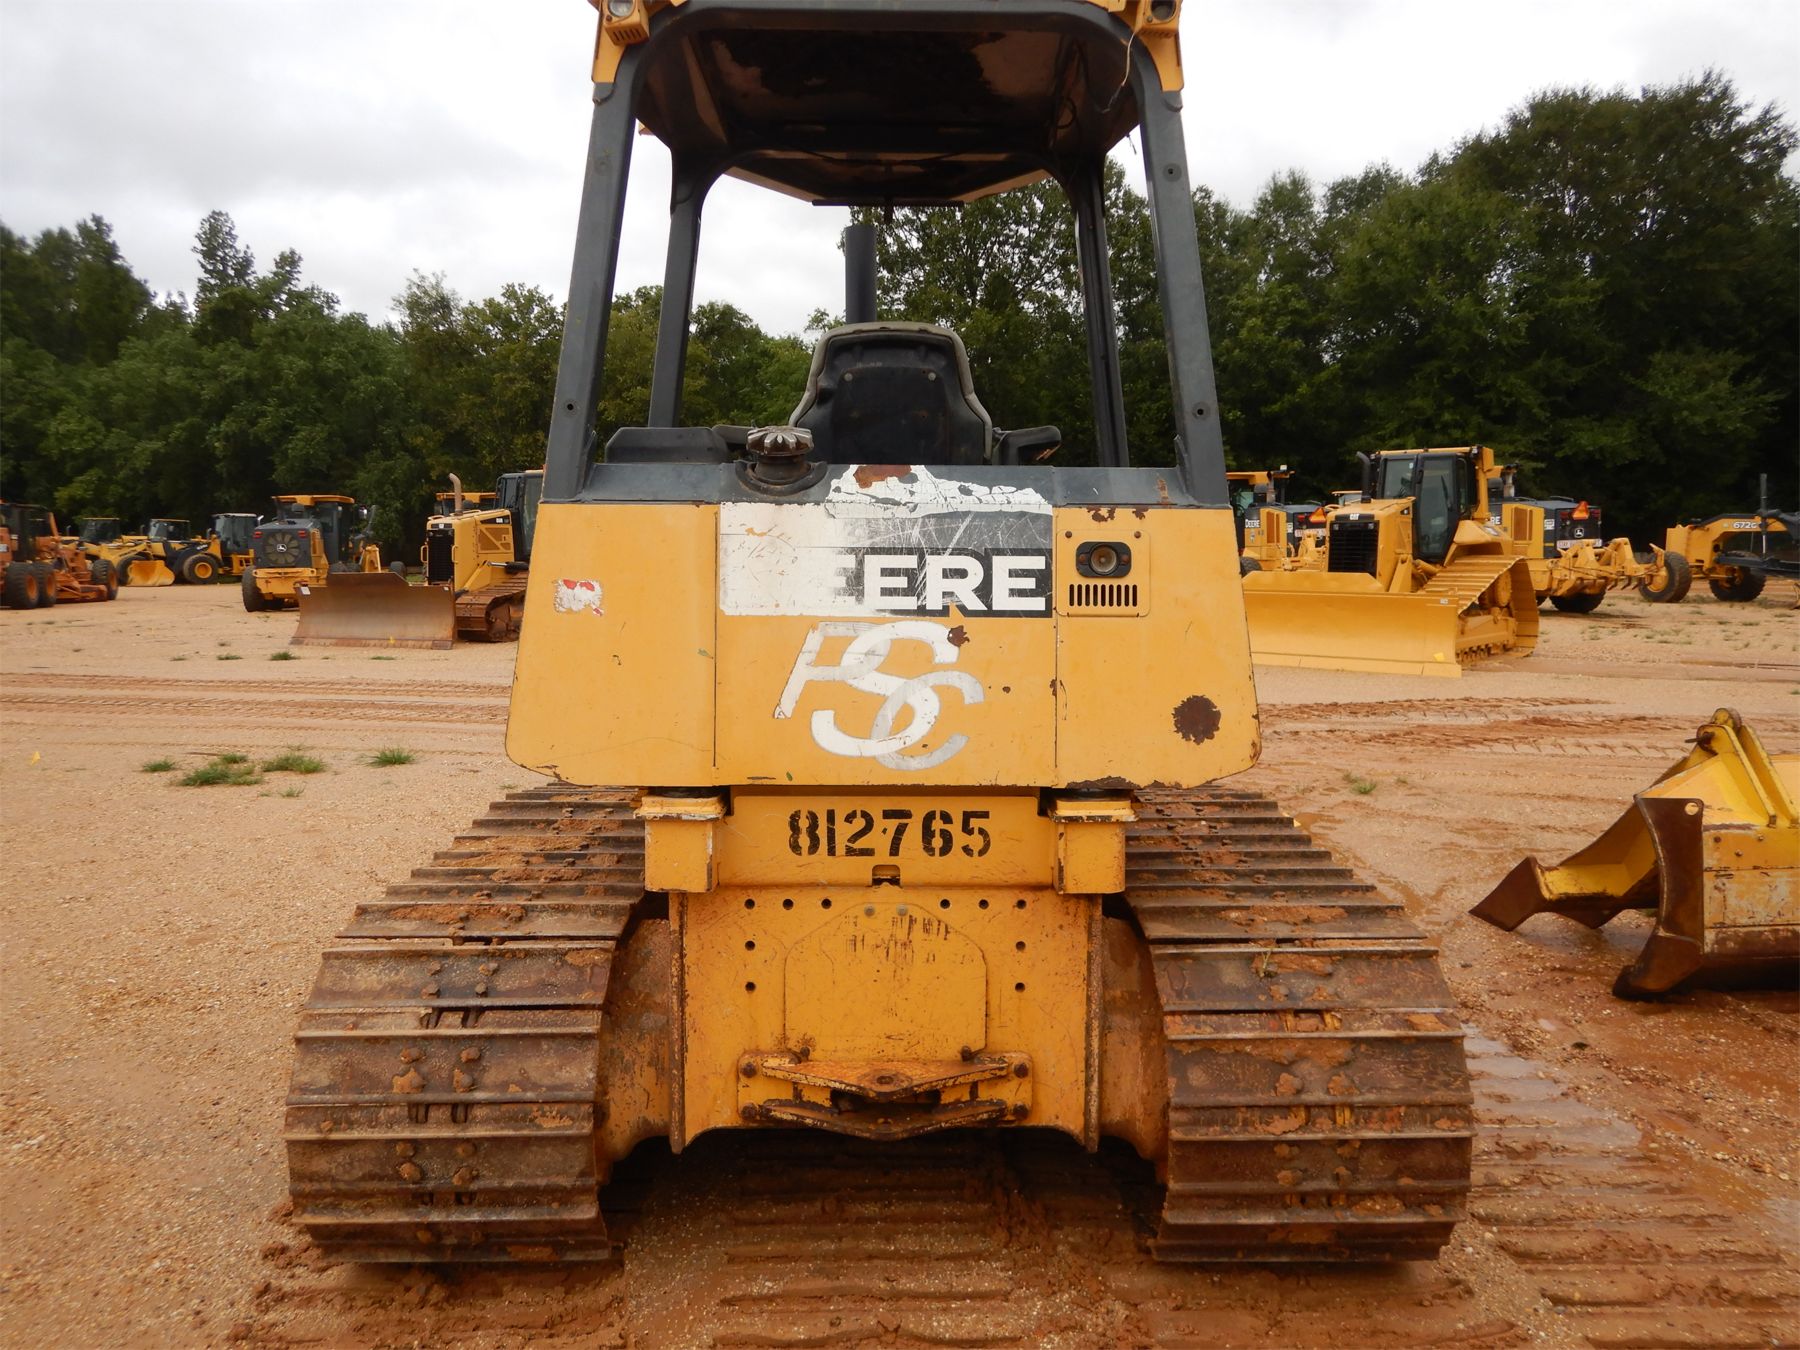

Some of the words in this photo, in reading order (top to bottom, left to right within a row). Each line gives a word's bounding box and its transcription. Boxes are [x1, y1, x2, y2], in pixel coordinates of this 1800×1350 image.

[1349, 513, 1360, 521] CAT
[1244, 518, 1260, 528] DEERE
[788, 809, 992, 857] 812765
